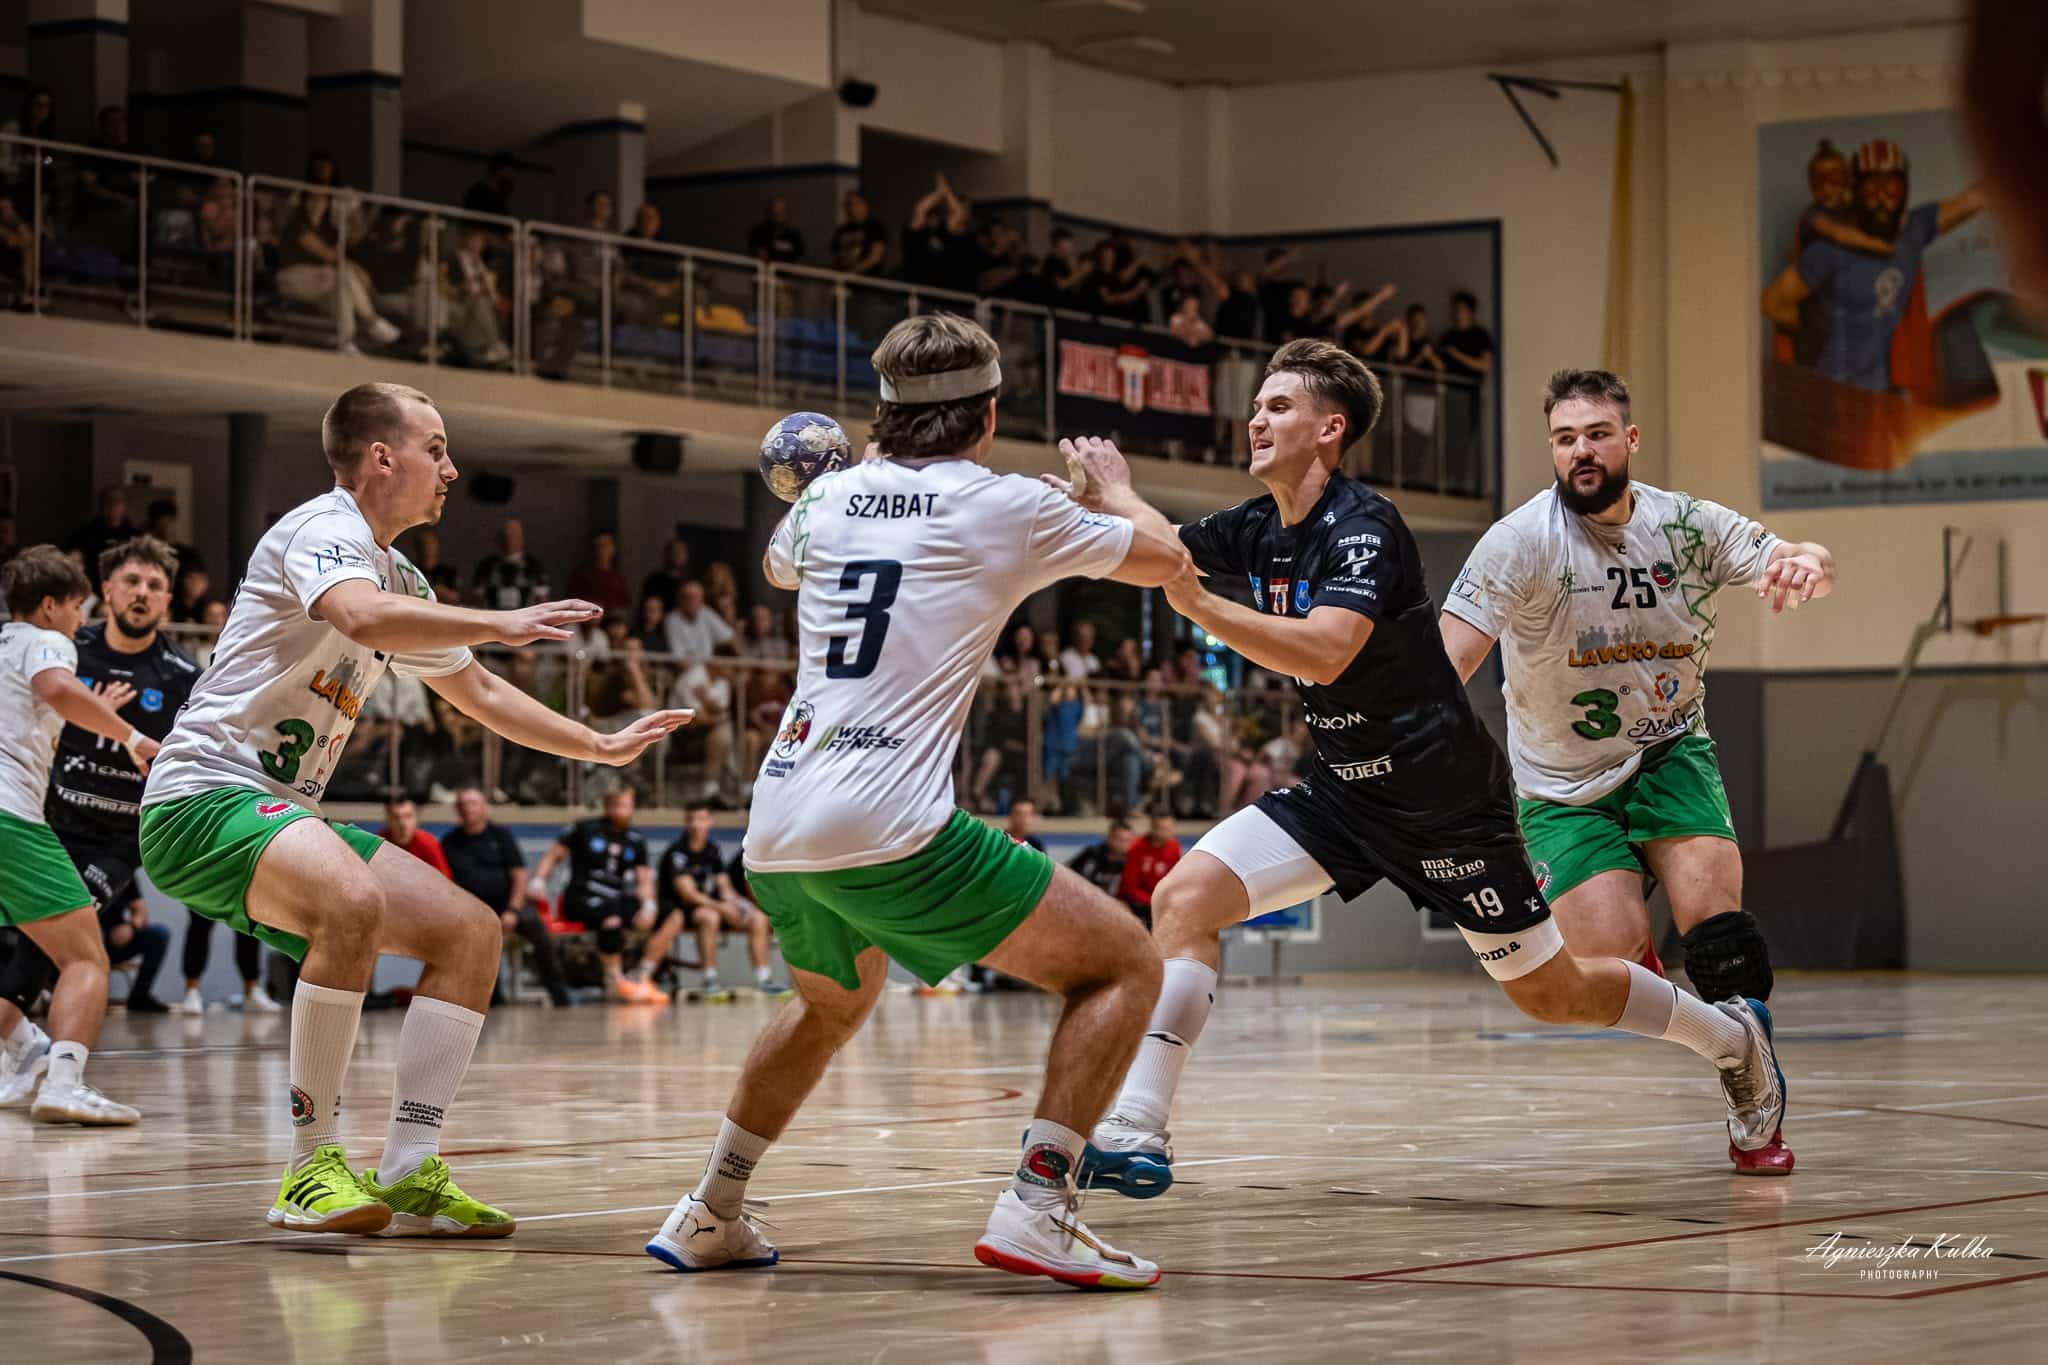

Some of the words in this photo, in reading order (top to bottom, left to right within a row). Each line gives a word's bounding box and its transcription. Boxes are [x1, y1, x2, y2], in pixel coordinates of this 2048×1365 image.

[846, 494, 938, 519] SZABAT
[1607, 567, 1657, 609] 25
[826, 560, 903, 679] 3
[1568, 640, 1657, 667] LAVORO
[838, 726, 887, 739] WILL
[826, 737, 906, 752] FITNESS
[1420, 857, 1456, 872] max
[1424, 859, 1486, 880] ELEKTRO
[1463, 887, 1505, 918] 19
[410, 1112, 434, 1120] TEAM
